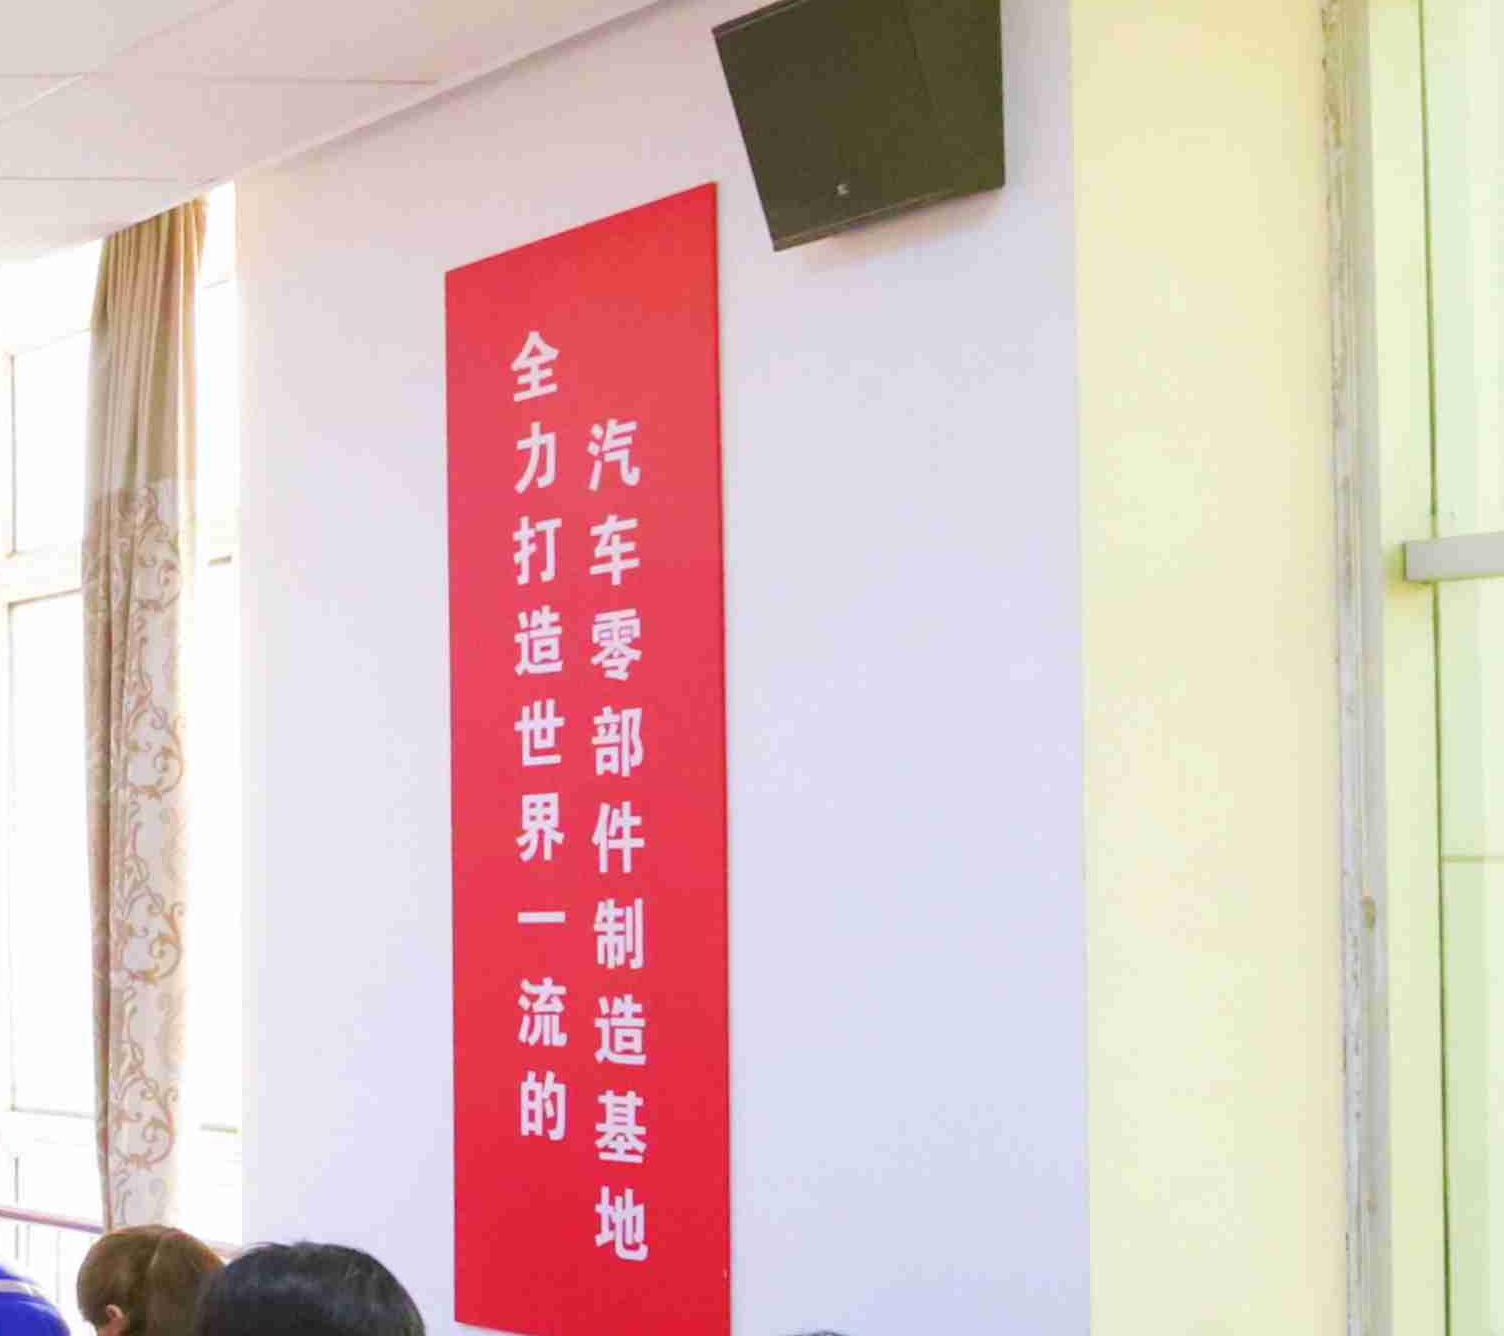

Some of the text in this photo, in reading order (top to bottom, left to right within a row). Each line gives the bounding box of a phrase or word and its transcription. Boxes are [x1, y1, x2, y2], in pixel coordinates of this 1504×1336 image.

[510, 329, 568, 1143] 全力打造世界一流的
[585, 417, 650, 1262] 汽车零部件制造基地
